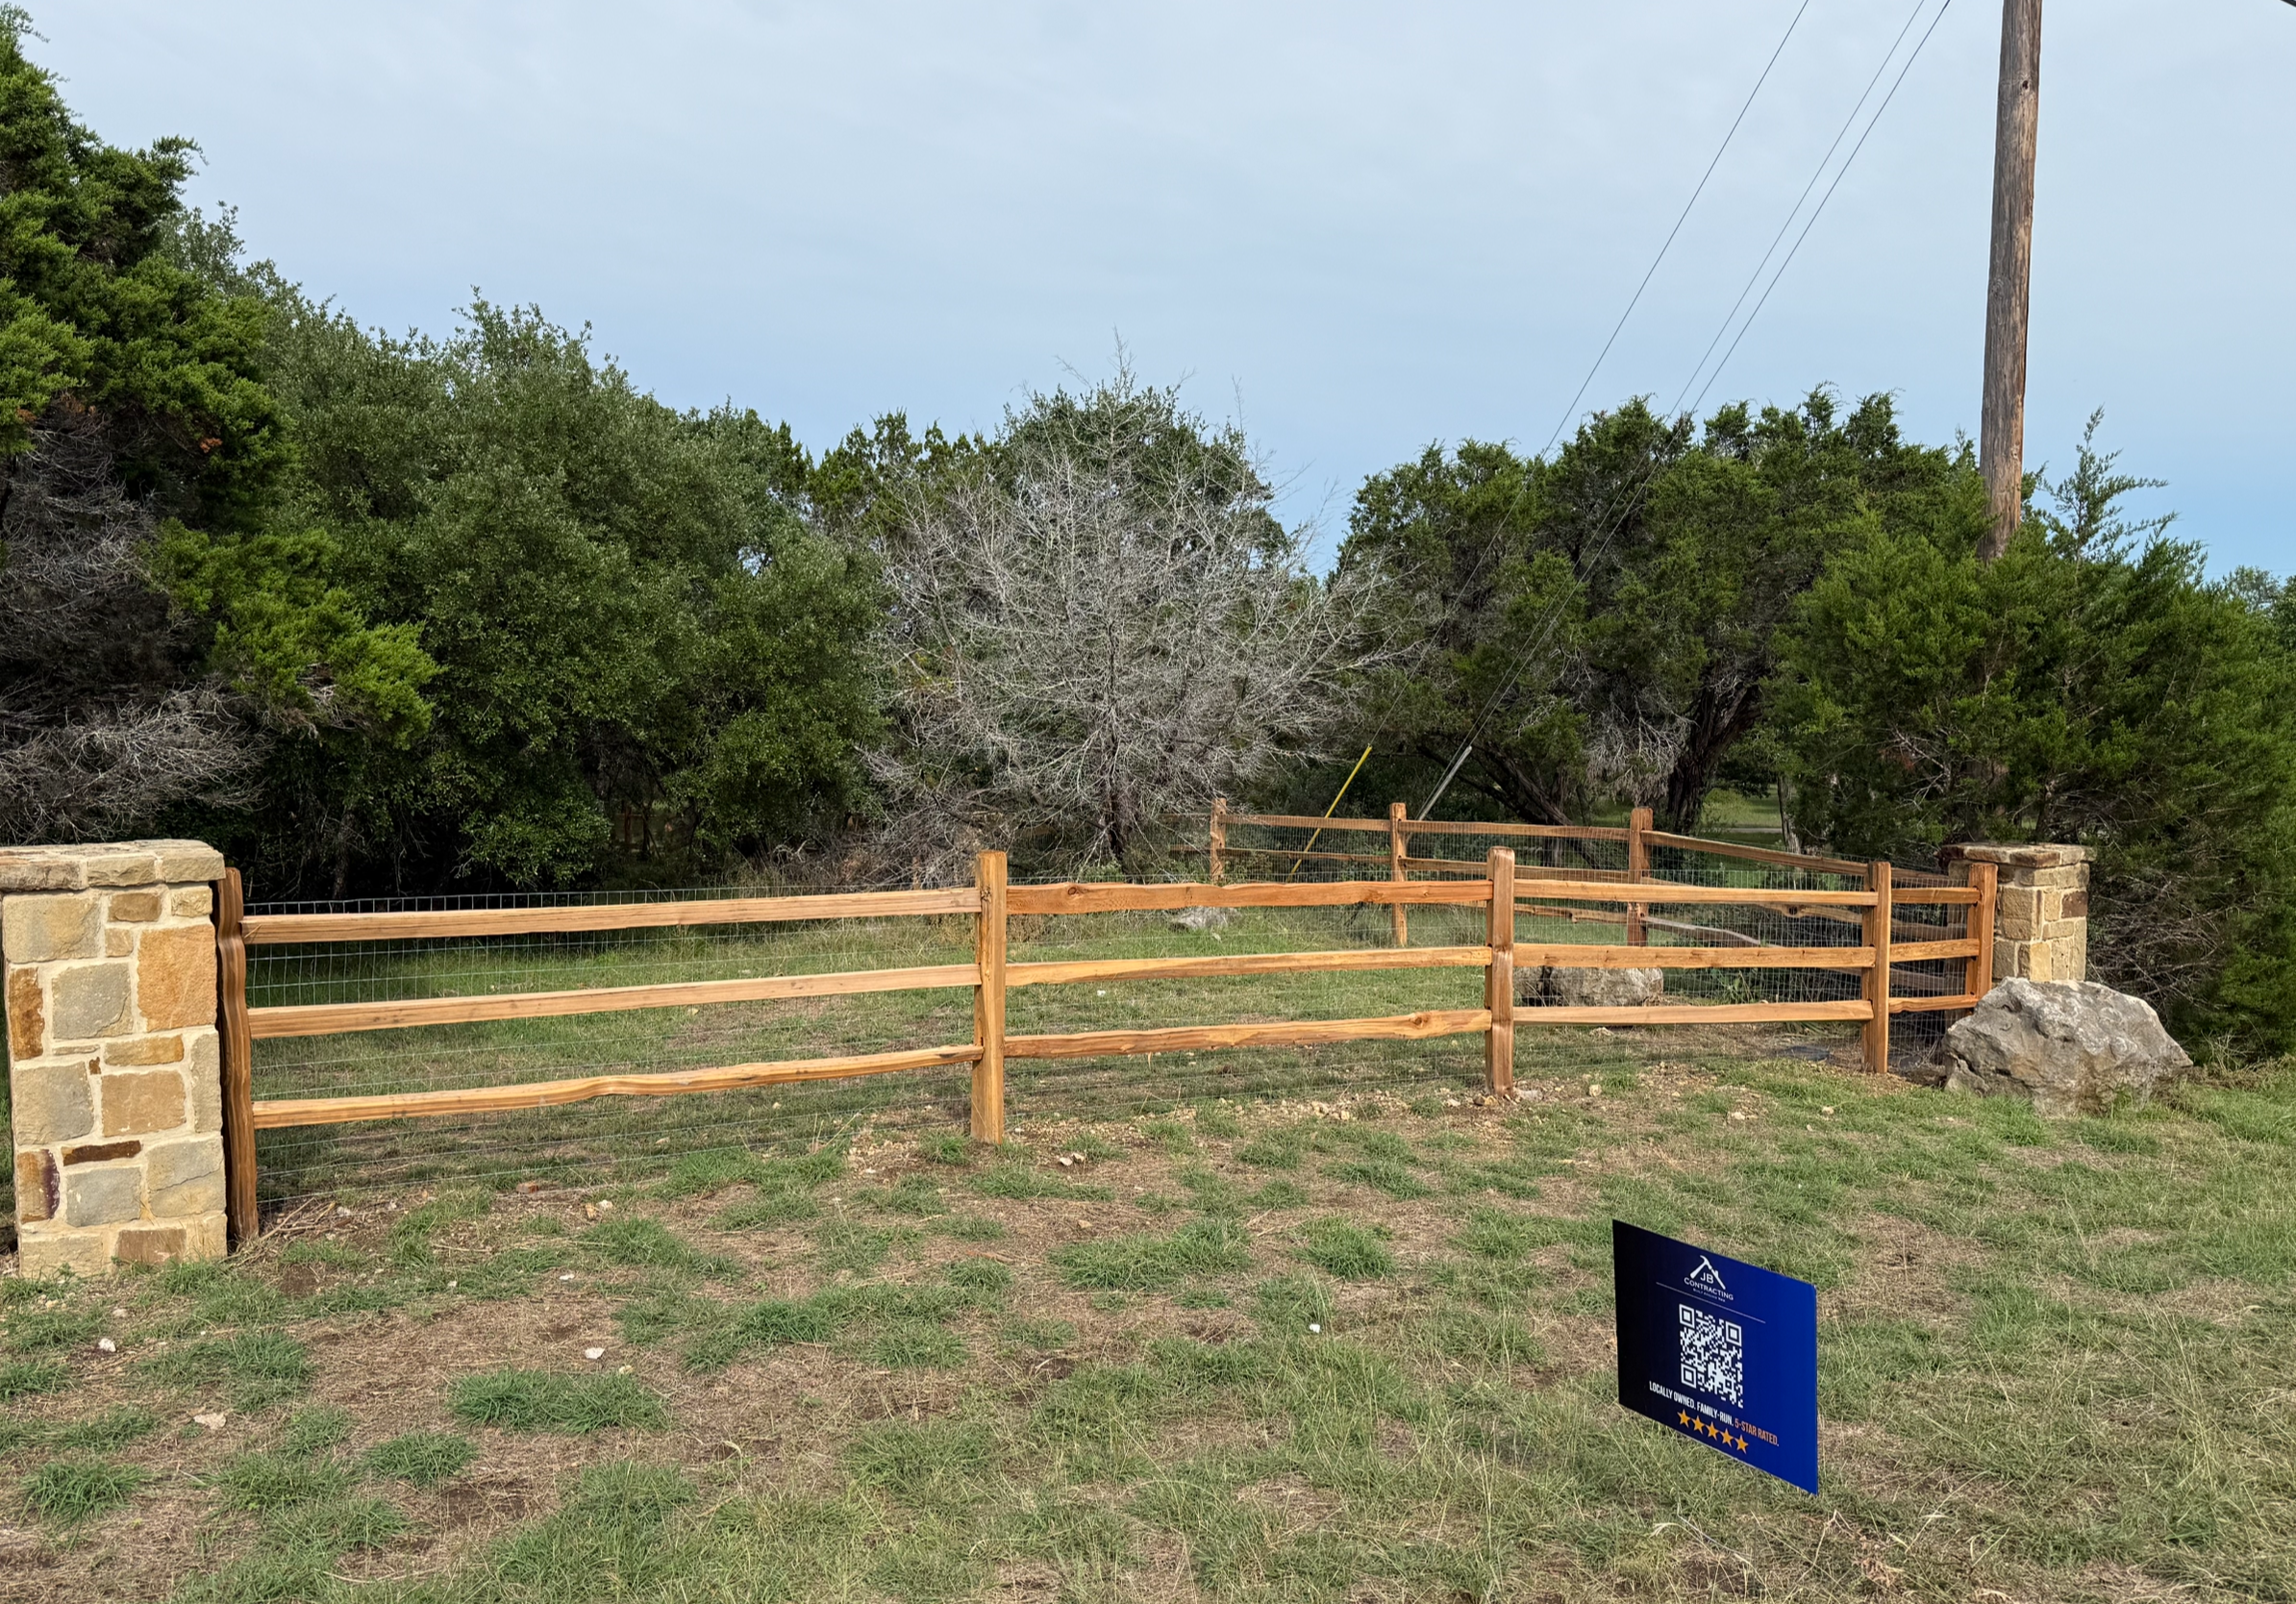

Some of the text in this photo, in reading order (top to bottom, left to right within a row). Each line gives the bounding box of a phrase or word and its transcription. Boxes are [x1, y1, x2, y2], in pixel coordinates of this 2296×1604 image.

[1684, 1277, 1734, 1301] CONTRACTING
[1700, 1272, 1714, 1285] JB
[1649, 1380, 1780, 1447] LOCALLY OWNED. FAMILY-RUN. 5-STAR RATED.
